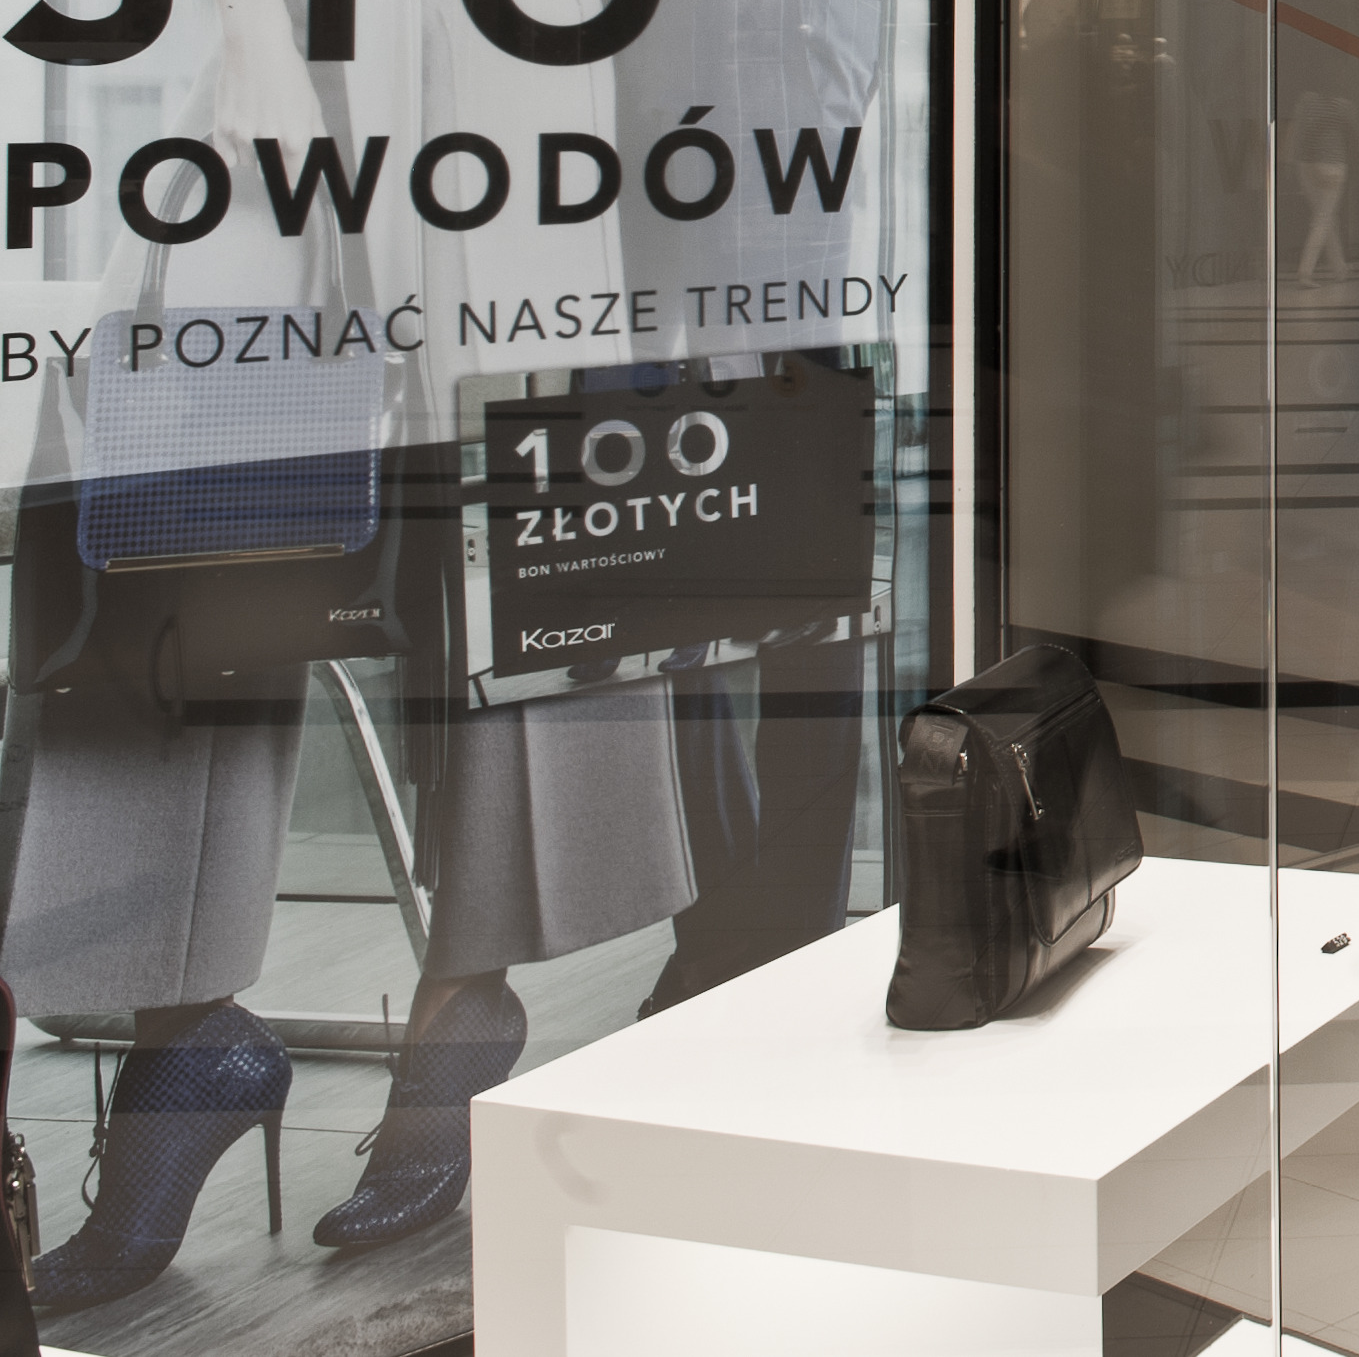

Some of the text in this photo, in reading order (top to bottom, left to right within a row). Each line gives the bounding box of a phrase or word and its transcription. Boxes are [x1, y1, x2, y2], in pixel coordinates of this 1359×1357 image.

[5, 105, 863, 250] POWODÓW
[0, 274, 909, 384] BY POZNAĆ NASZE TRENDY
[515, 410, 730, 494] 100
[516, 483, 759, 548] ZŁOTYCH
[518, 547, 667, 580] BON WARTOŚCIOWY
[521, 620, 616, 653] Kazar
